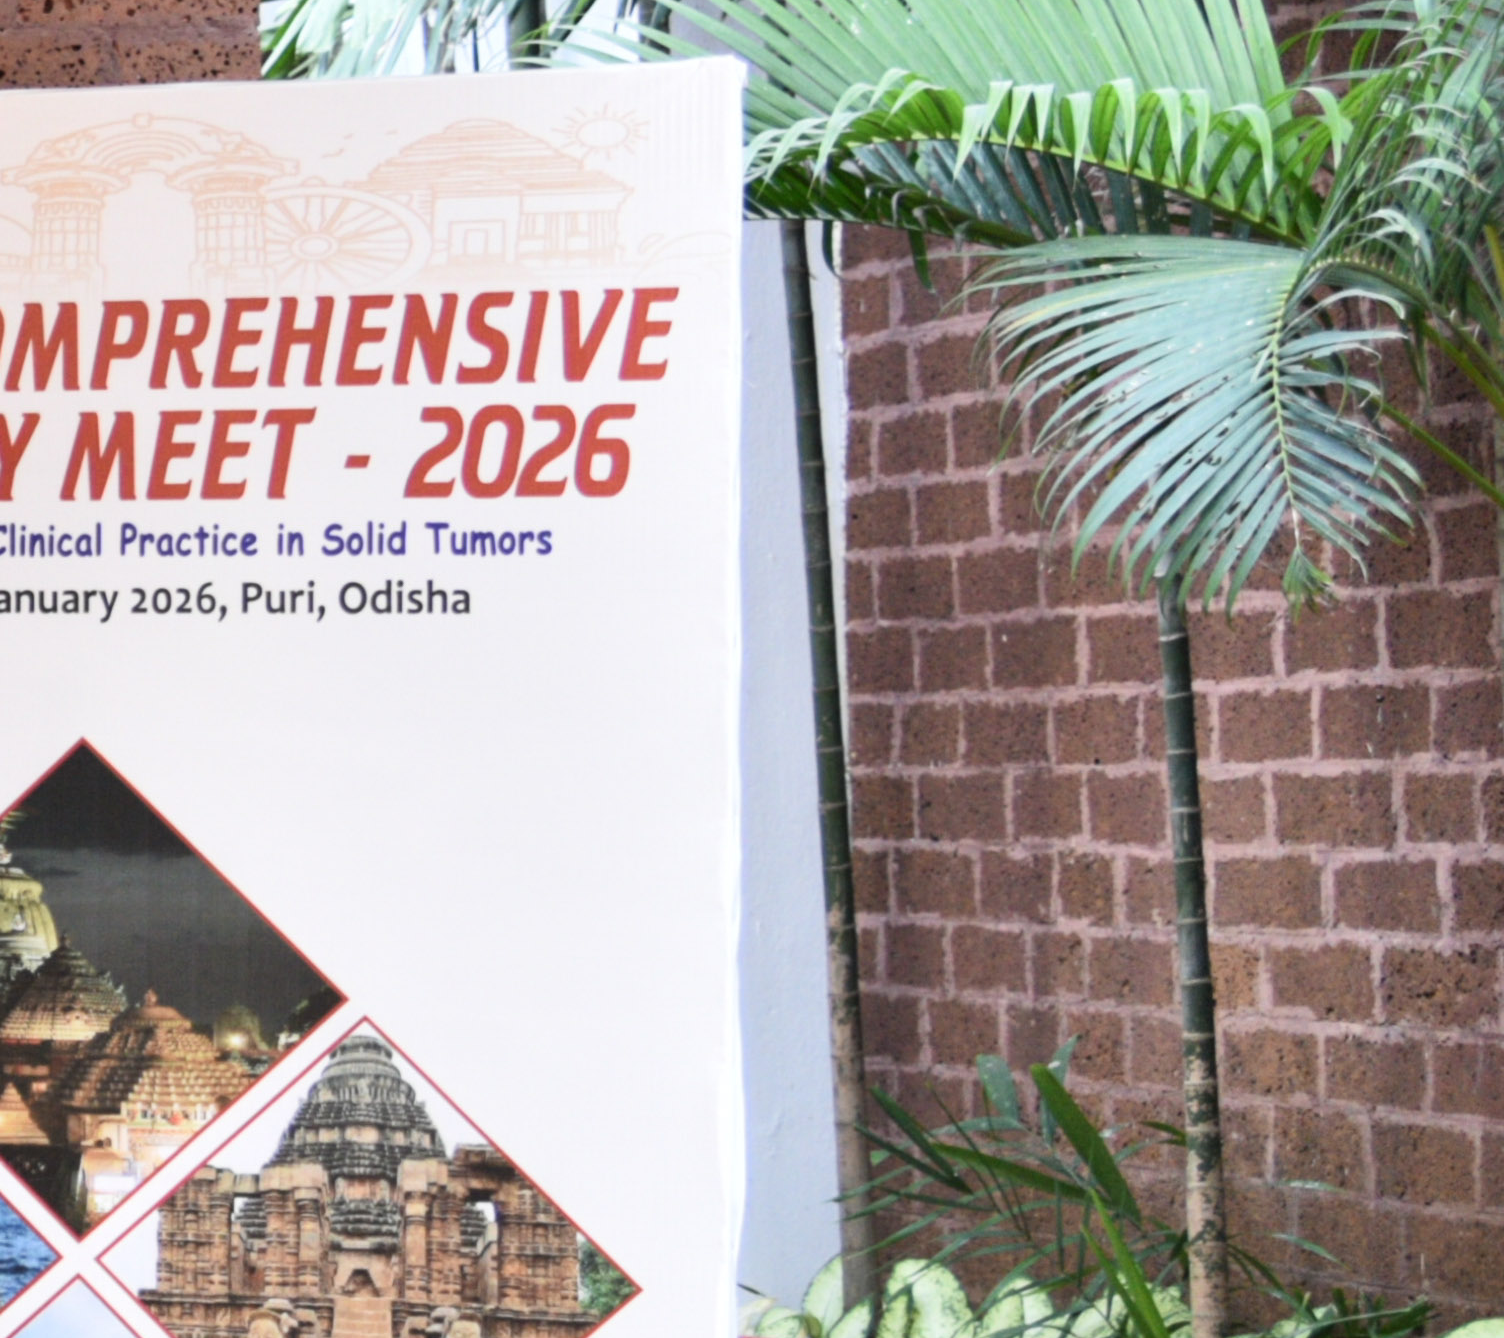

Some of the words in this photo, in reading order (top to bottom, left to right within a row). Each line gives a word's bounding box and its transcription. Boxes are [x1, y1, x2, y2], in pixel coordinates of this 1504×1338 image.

[60, 407, 316, 501] MEET
[345, 455, 370, 468] -
[404, 404, 636, 498] 2026
[120, 522, 257, 557] Practice
[278, 524, 304, 556] in
[322, 521, 406, 556] Solid
[425, 522, 552, 556] Tumors
[131, 582, 227, 621] 2026,
[242, 580, 325, 621] Puri,
[339, 580, 470, 614] Odisha
